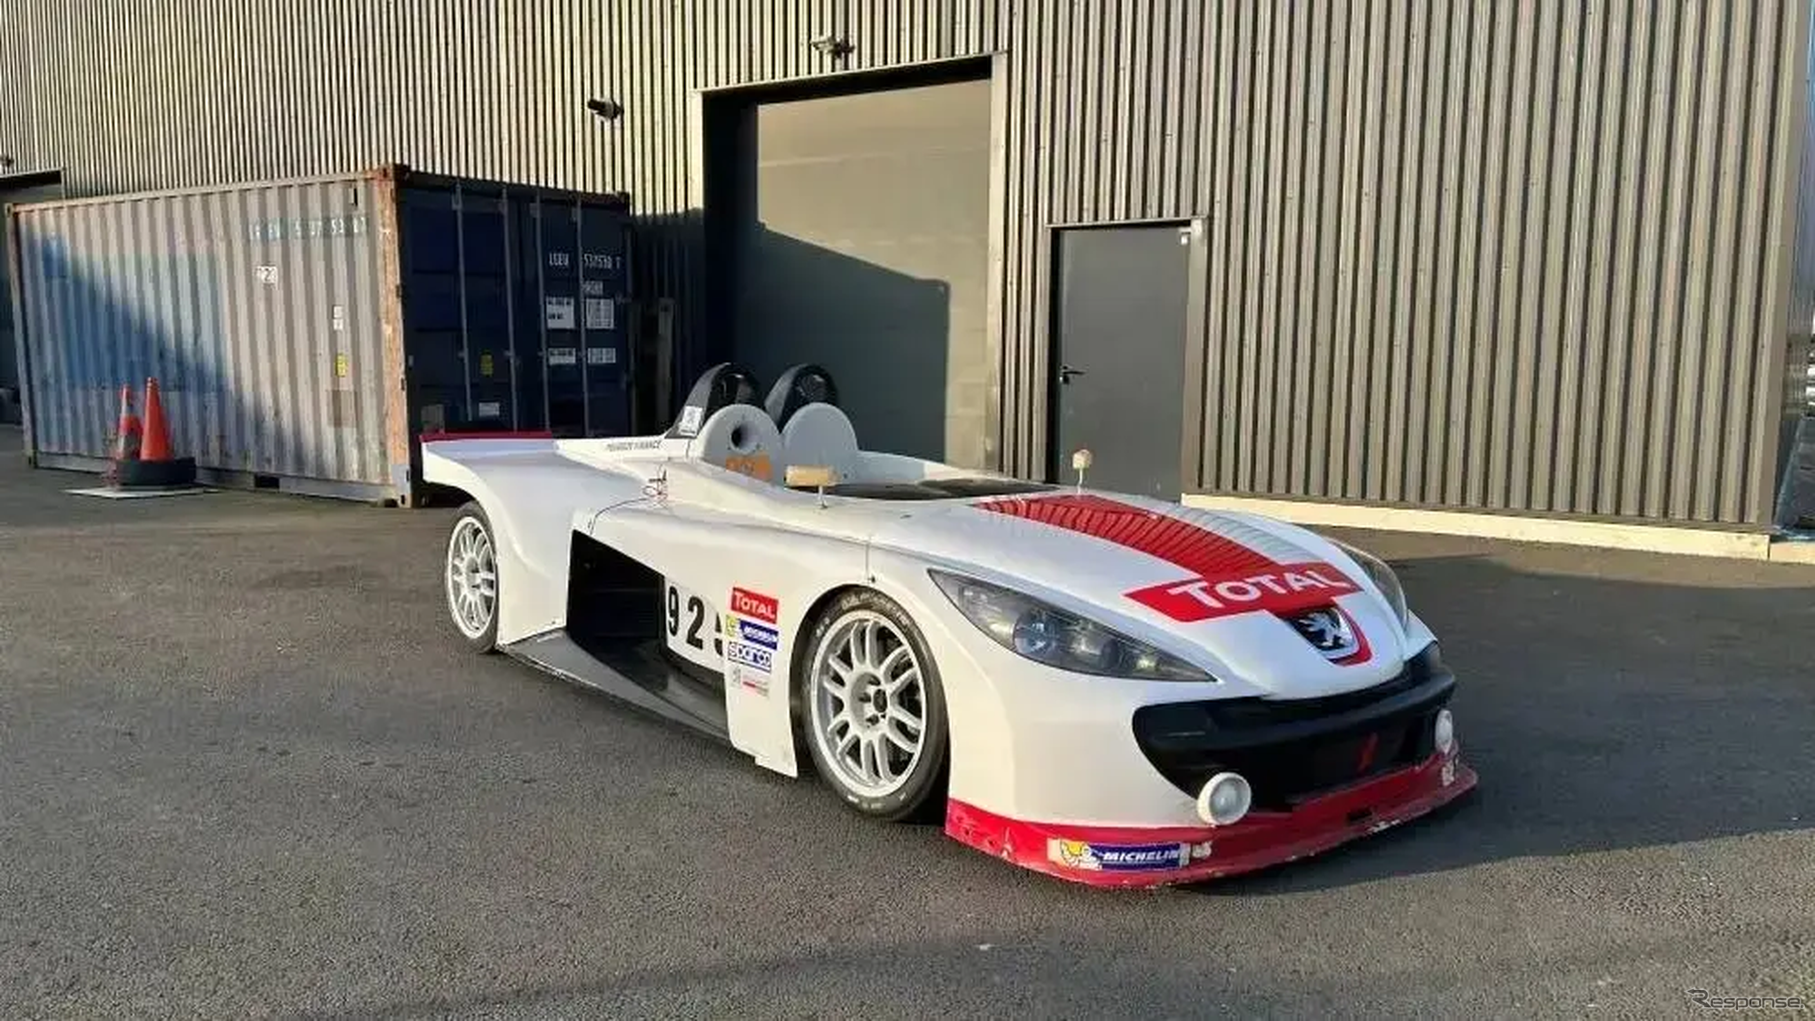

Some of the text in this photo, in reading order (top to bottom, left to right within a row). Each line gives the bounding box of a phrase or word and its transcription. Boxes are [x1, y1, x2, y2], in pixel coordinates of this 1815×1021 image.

[1168, 570, 1351, 608] TOTAL
[733, 591, 776, 619] TOTAL
[1102, 849, 1179, 861] MICHELIN
